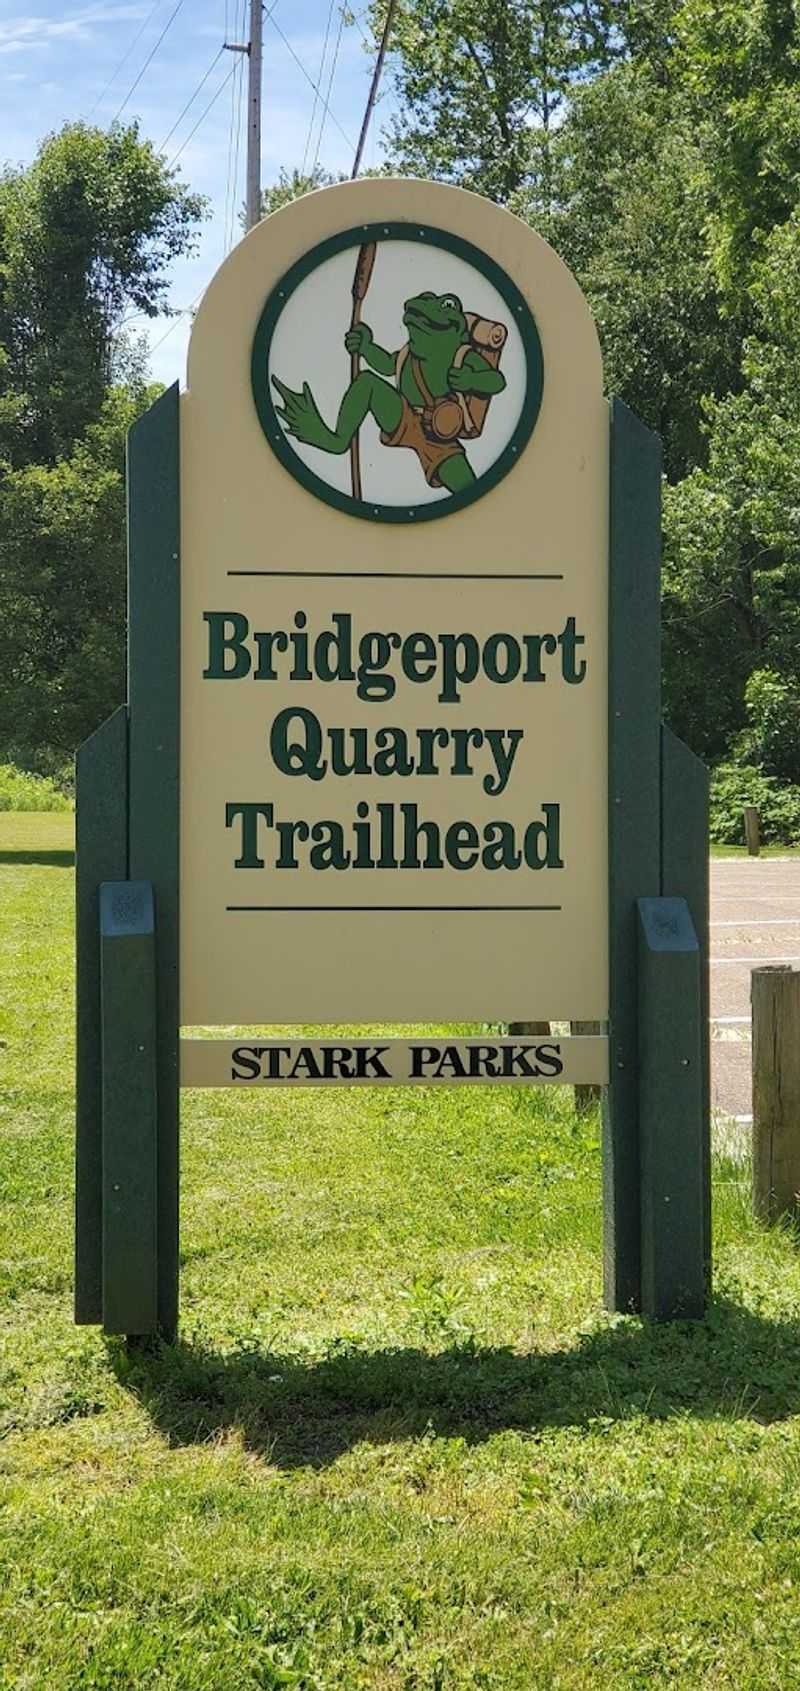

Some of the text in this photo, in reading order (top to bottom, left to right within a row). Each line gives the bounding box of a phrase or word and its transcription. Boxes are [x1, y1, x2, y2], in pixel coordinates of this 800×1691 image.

[203, 611, 587, 703] Bridgeport
[269, 706, 524, 796] Quarry
[225, 801, 565, 870] Trailhead
[231, 1044, 564, 1080] STARK PARKS
